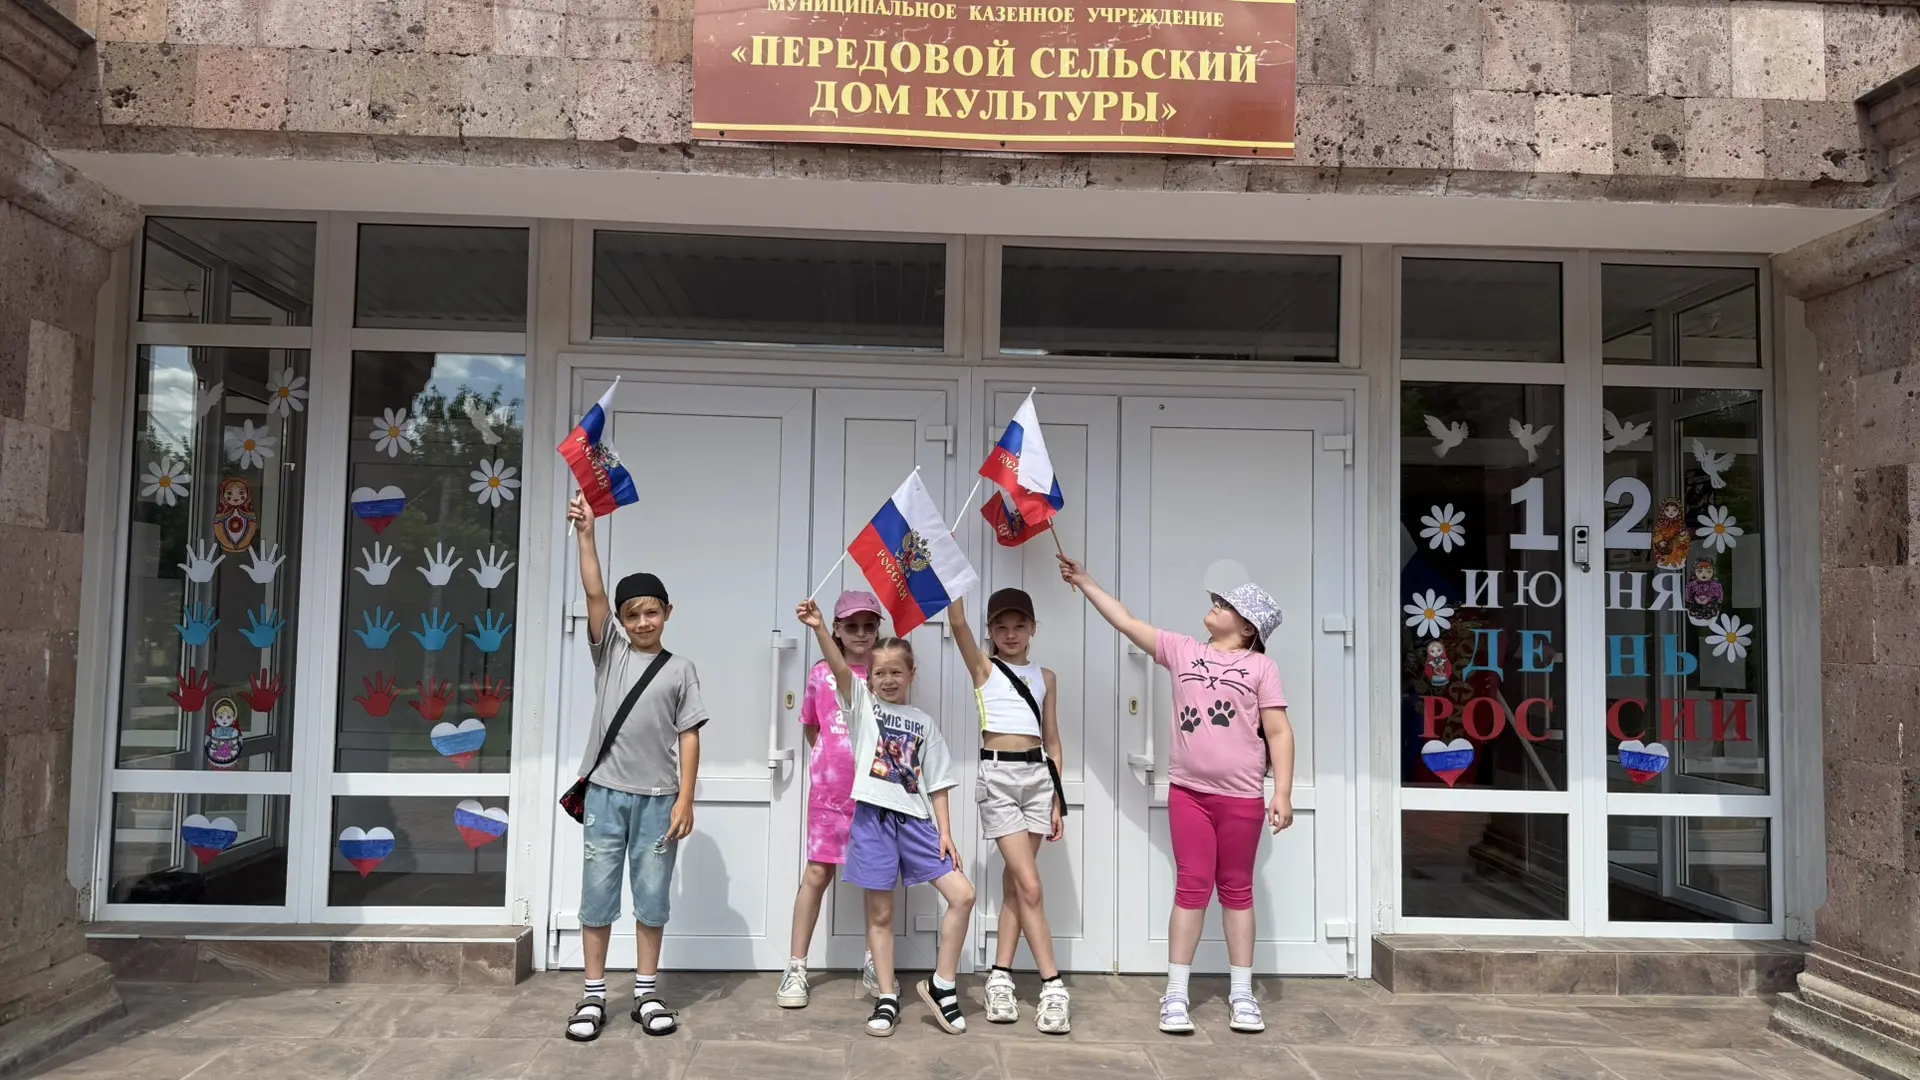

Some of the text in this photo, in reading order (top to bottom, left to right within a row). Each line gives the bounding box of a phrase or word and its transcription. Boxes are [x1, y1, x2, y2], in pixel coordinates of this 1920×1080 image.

[767, 0, 1224, 28] МУНИЦИПАЛЬНОЕ КАЗЕННОЕ УЧРЕЖДЕНИЕ
[731, 35, 1258, 84] «ПЕРЕДОВОЙ СЕЛЬСКИЙ
[809, 80, 1177, 122] ДОМ КУЛЬТУРЫ»
[877, 549, 907, 601] РОССИЯ
